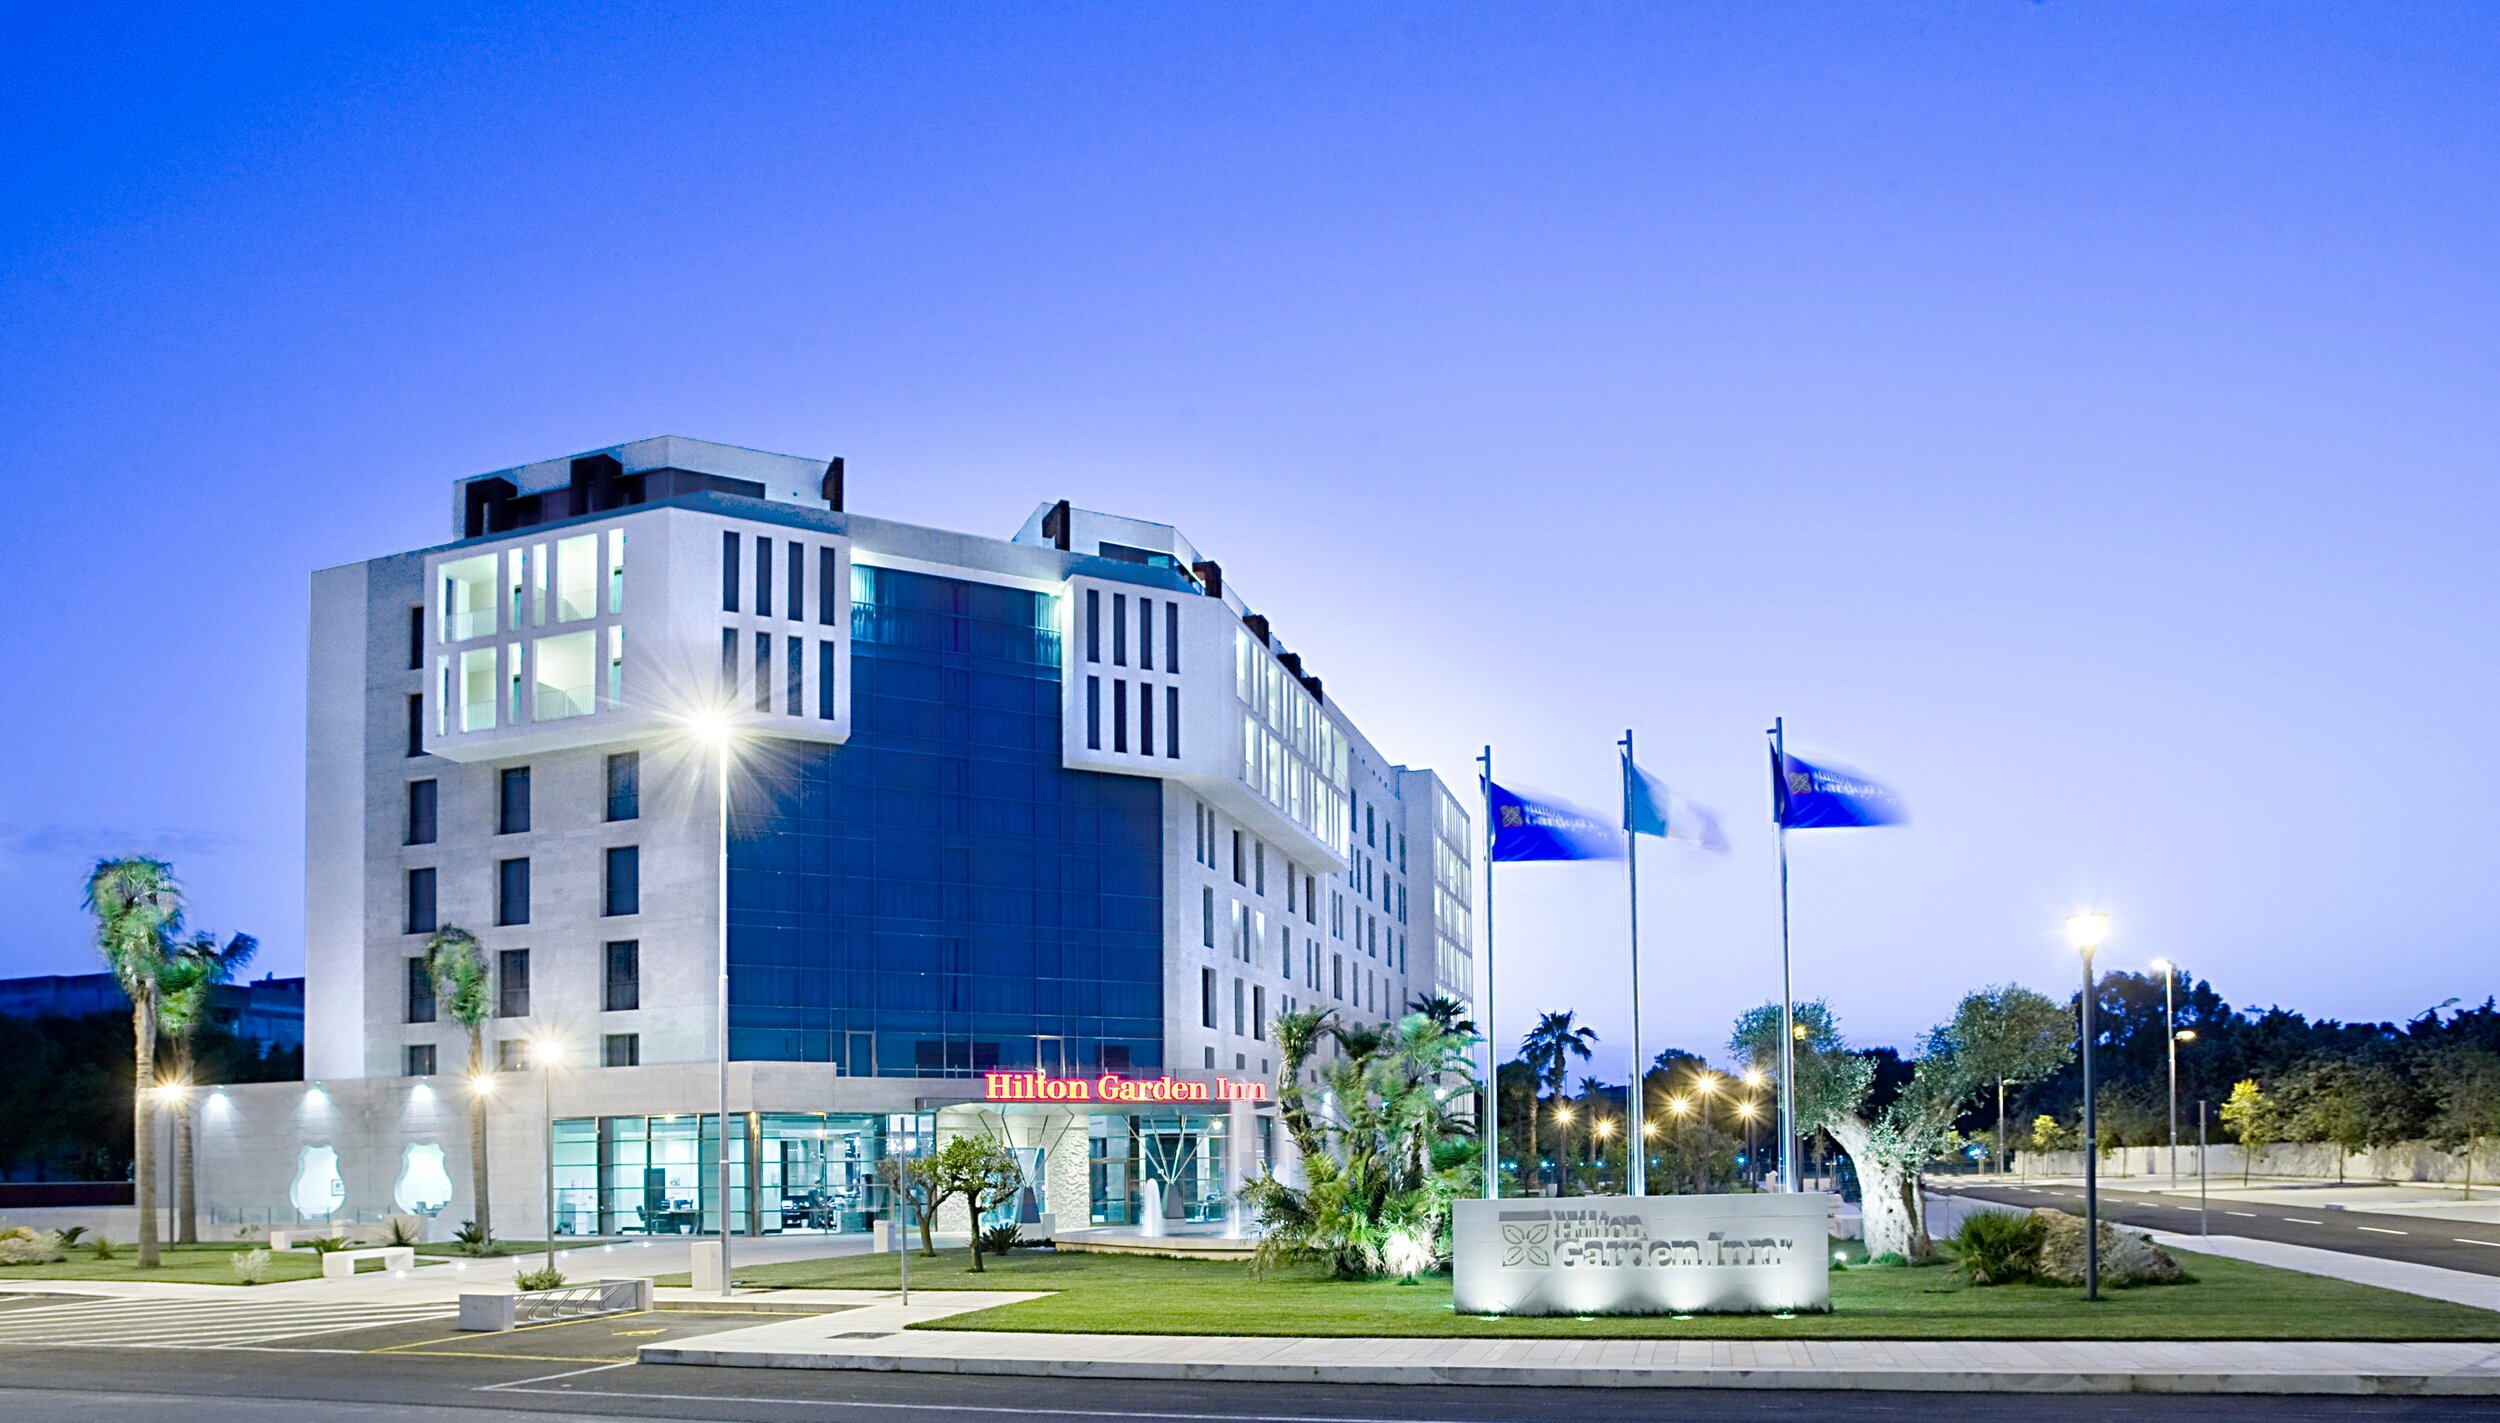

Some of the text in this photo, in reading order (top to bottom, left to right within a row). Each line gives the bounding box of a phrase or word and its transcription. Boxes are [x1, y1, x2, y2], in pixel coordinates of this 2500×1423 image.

[985, 1073, 1268, 1101] Hilton Garden Inn
[1554, 1210, 1647, 1240] Hilton
[1554, 1238, 1702, 1268] Garden
[1705, 1233, 1781, 1267] Inn
